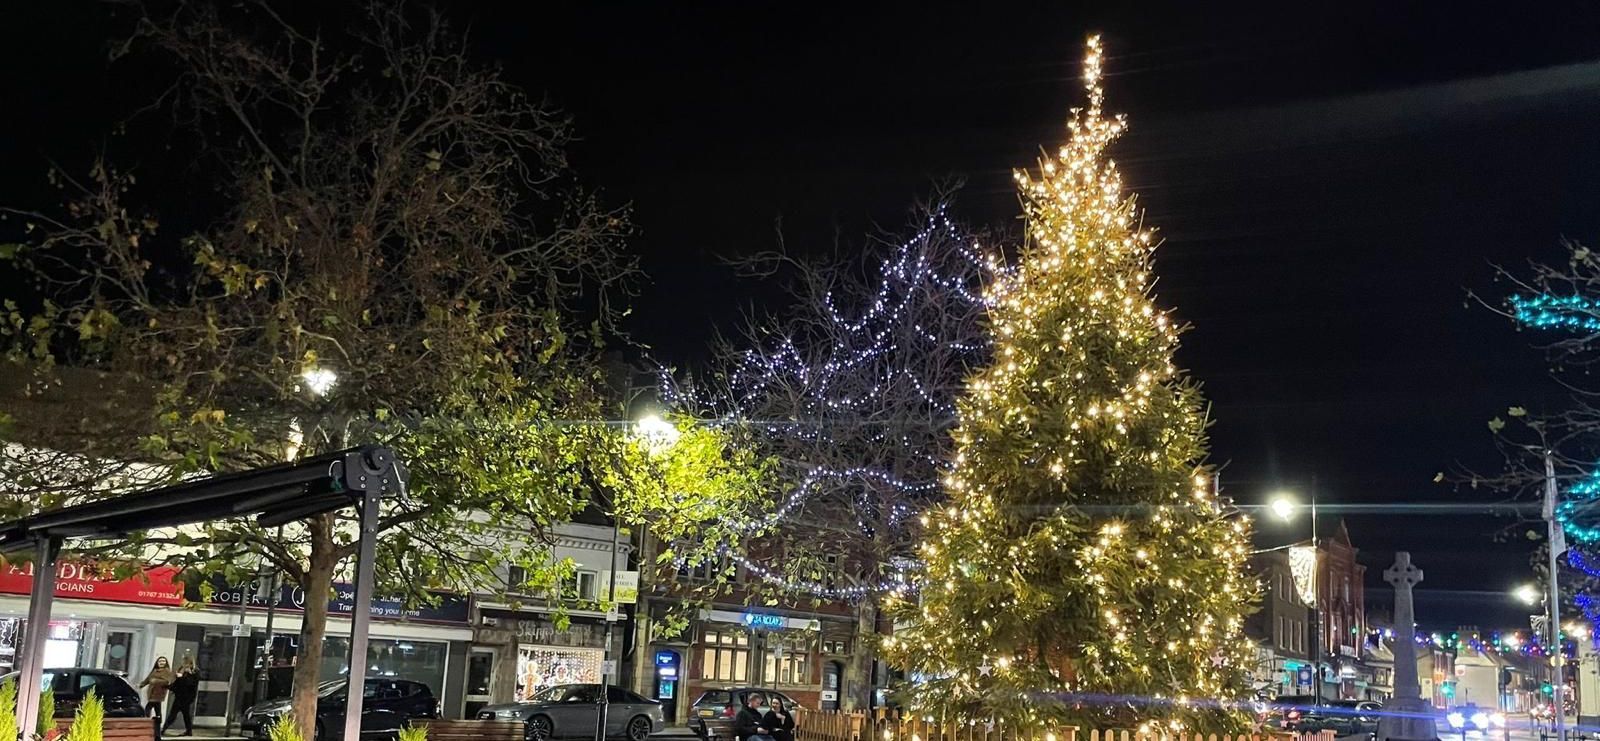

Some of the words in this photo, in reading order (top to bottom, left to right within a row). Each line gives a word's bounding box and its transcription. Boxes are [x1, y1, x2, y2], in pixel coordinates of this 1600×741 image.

[54, 581, 94, 593] ICIANS
[384, 608, 399, 616] your
[401, 607, 420, 617] me
